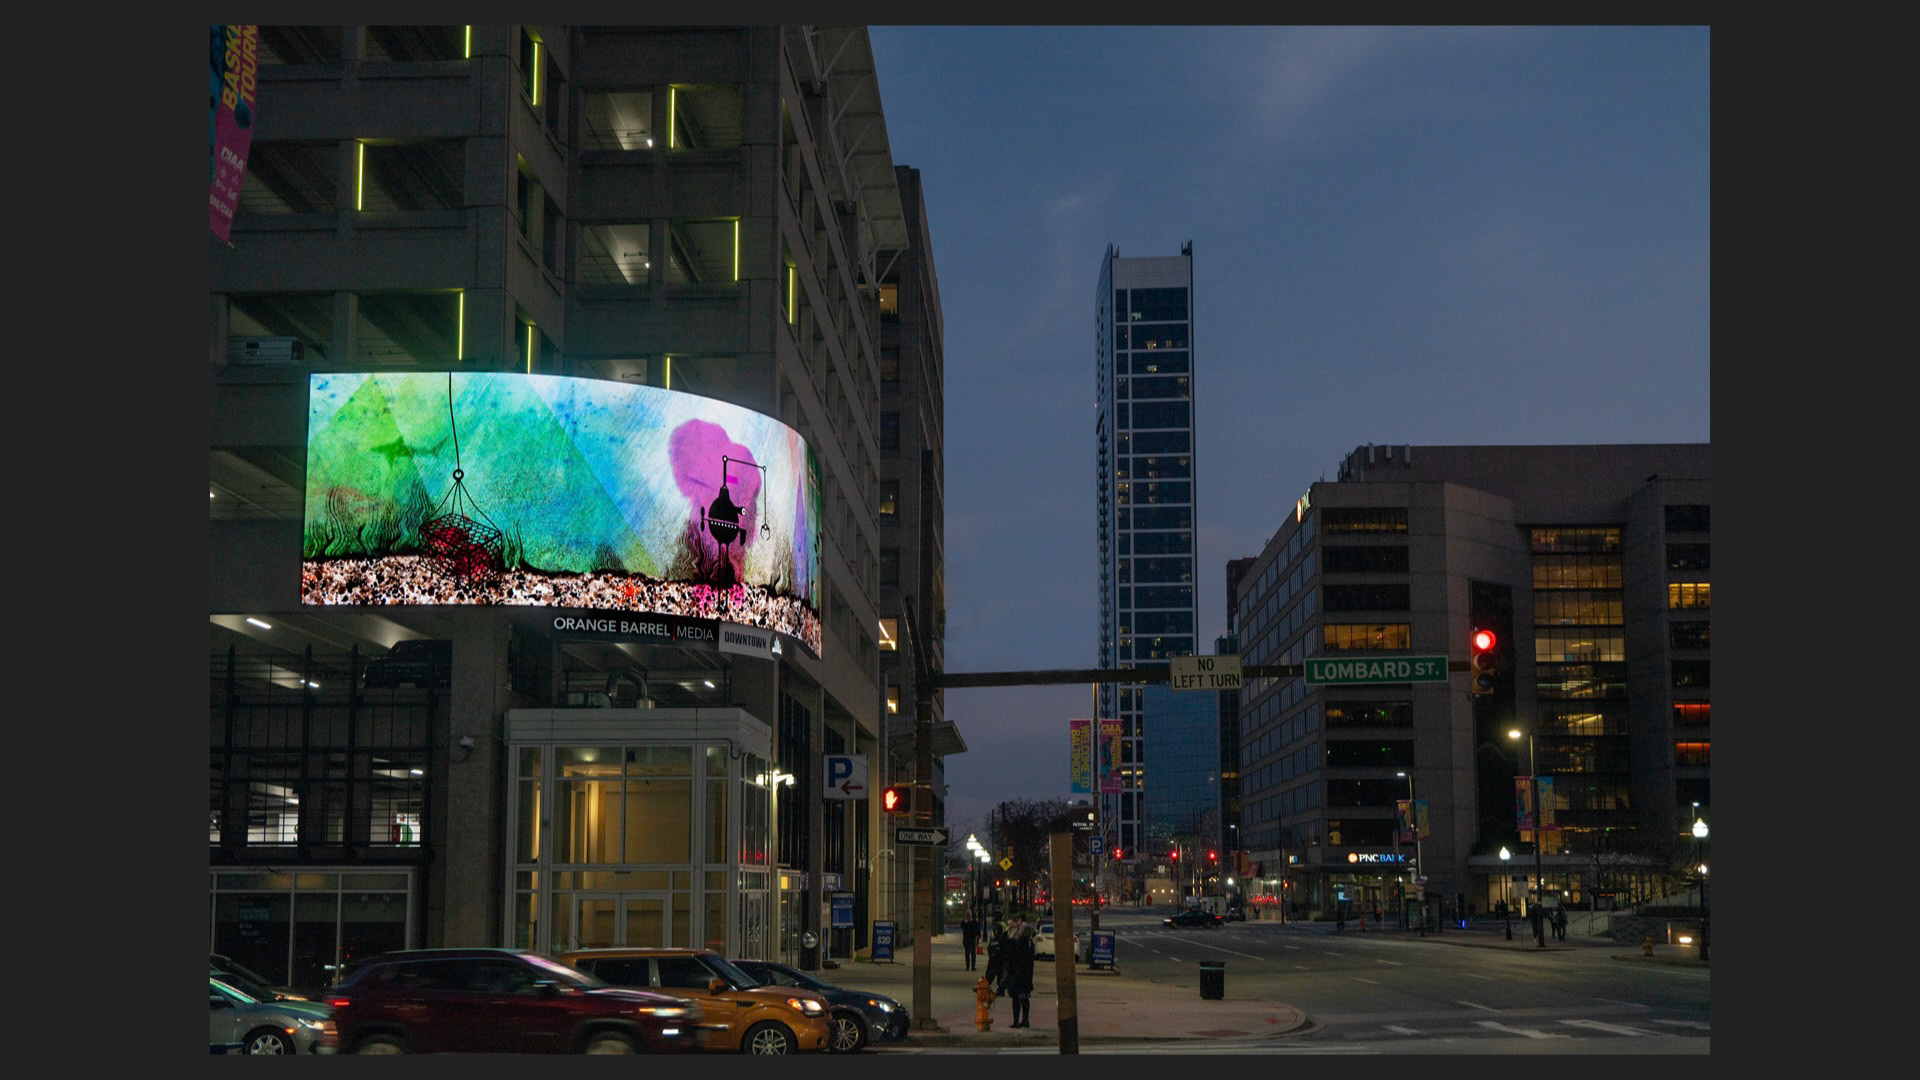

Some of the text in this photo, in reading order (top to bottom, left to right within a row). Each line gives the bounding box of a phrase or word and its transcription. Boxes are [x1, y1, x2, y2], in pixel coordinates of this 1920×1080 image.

[221, 146, 244, 175] CIAA
[553, 617, 714, 641] ORANGE BARREL MEDIA
[724, 631, 767, 650] DOWNTOWN
[1197, 658, 1214, 671] NO
[1313, 661, 1440, 680] LOMBARD ST.
[1174, 673, 1240, 688] LEFT TURN
[1072, 730, 1080, 783] BALTIMORE
[1081, 725, 1089, 772] WELCOME
[828, 757, 852, 788] P
[900, 832, 933, 842] ONE WAY
[1092, 839, 1101, 852] P
[877, 936, 891, 945] $20
